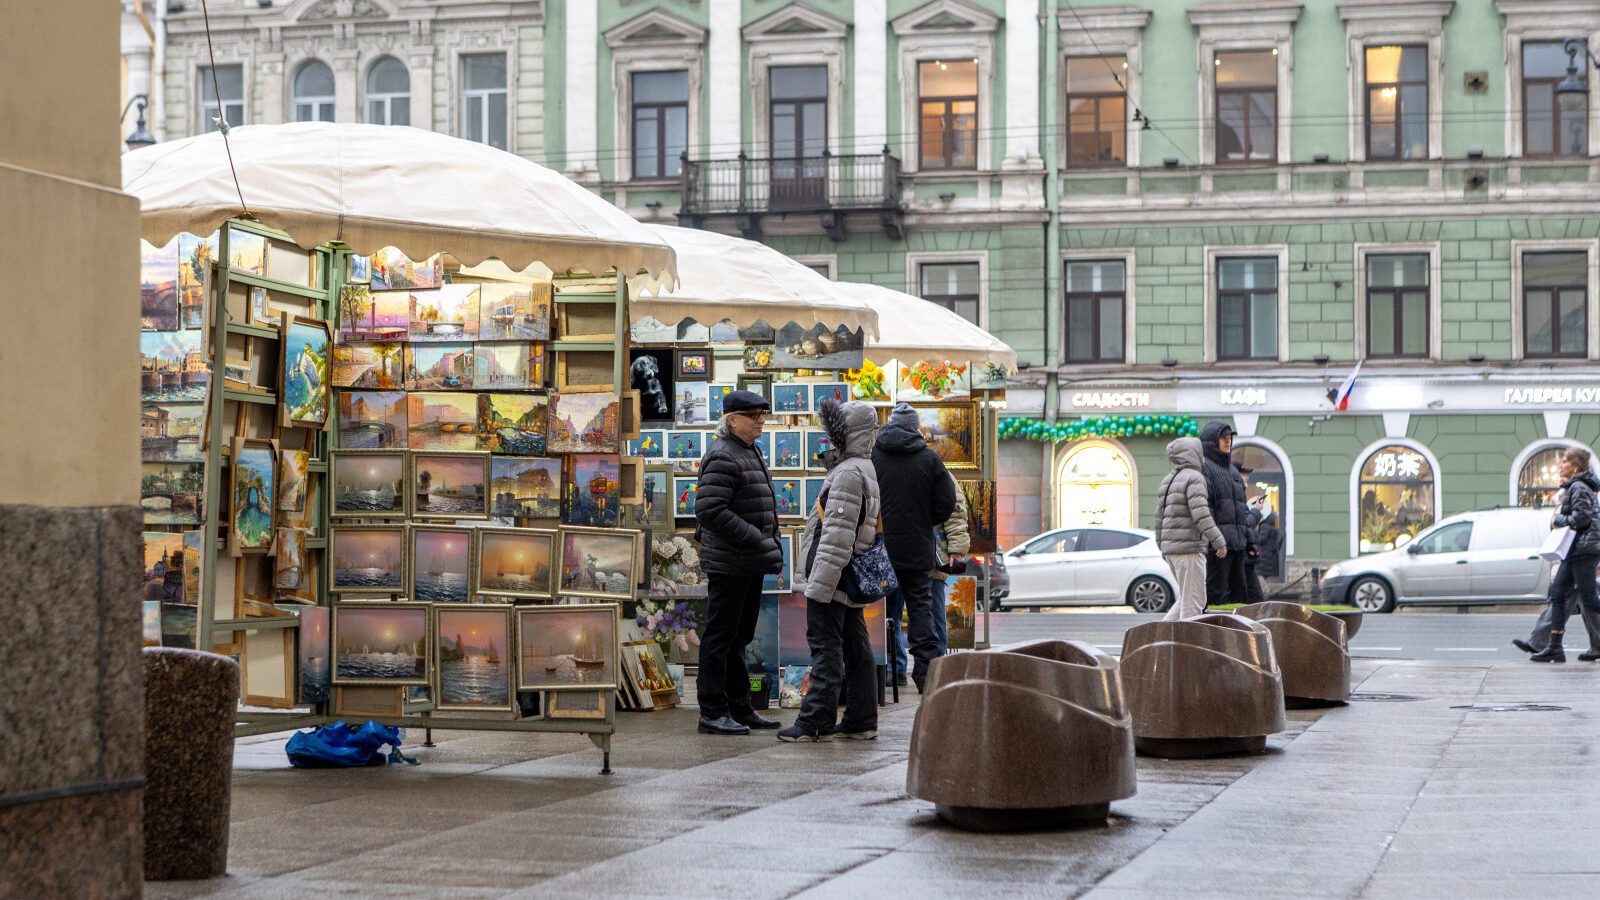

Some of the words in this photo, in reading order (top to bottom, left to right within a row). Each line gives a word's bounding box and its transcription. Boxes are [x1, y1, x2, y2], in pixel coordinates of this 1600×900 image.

[1071, 392, 1150, 409] СЛАДОСТИ
[1220, 387, 1267, 406] КАФЕ
[1504, 387, 1572, 403] ГАЛЕРЕЯ
[1374, 453, 1423, 477] 奶茶
